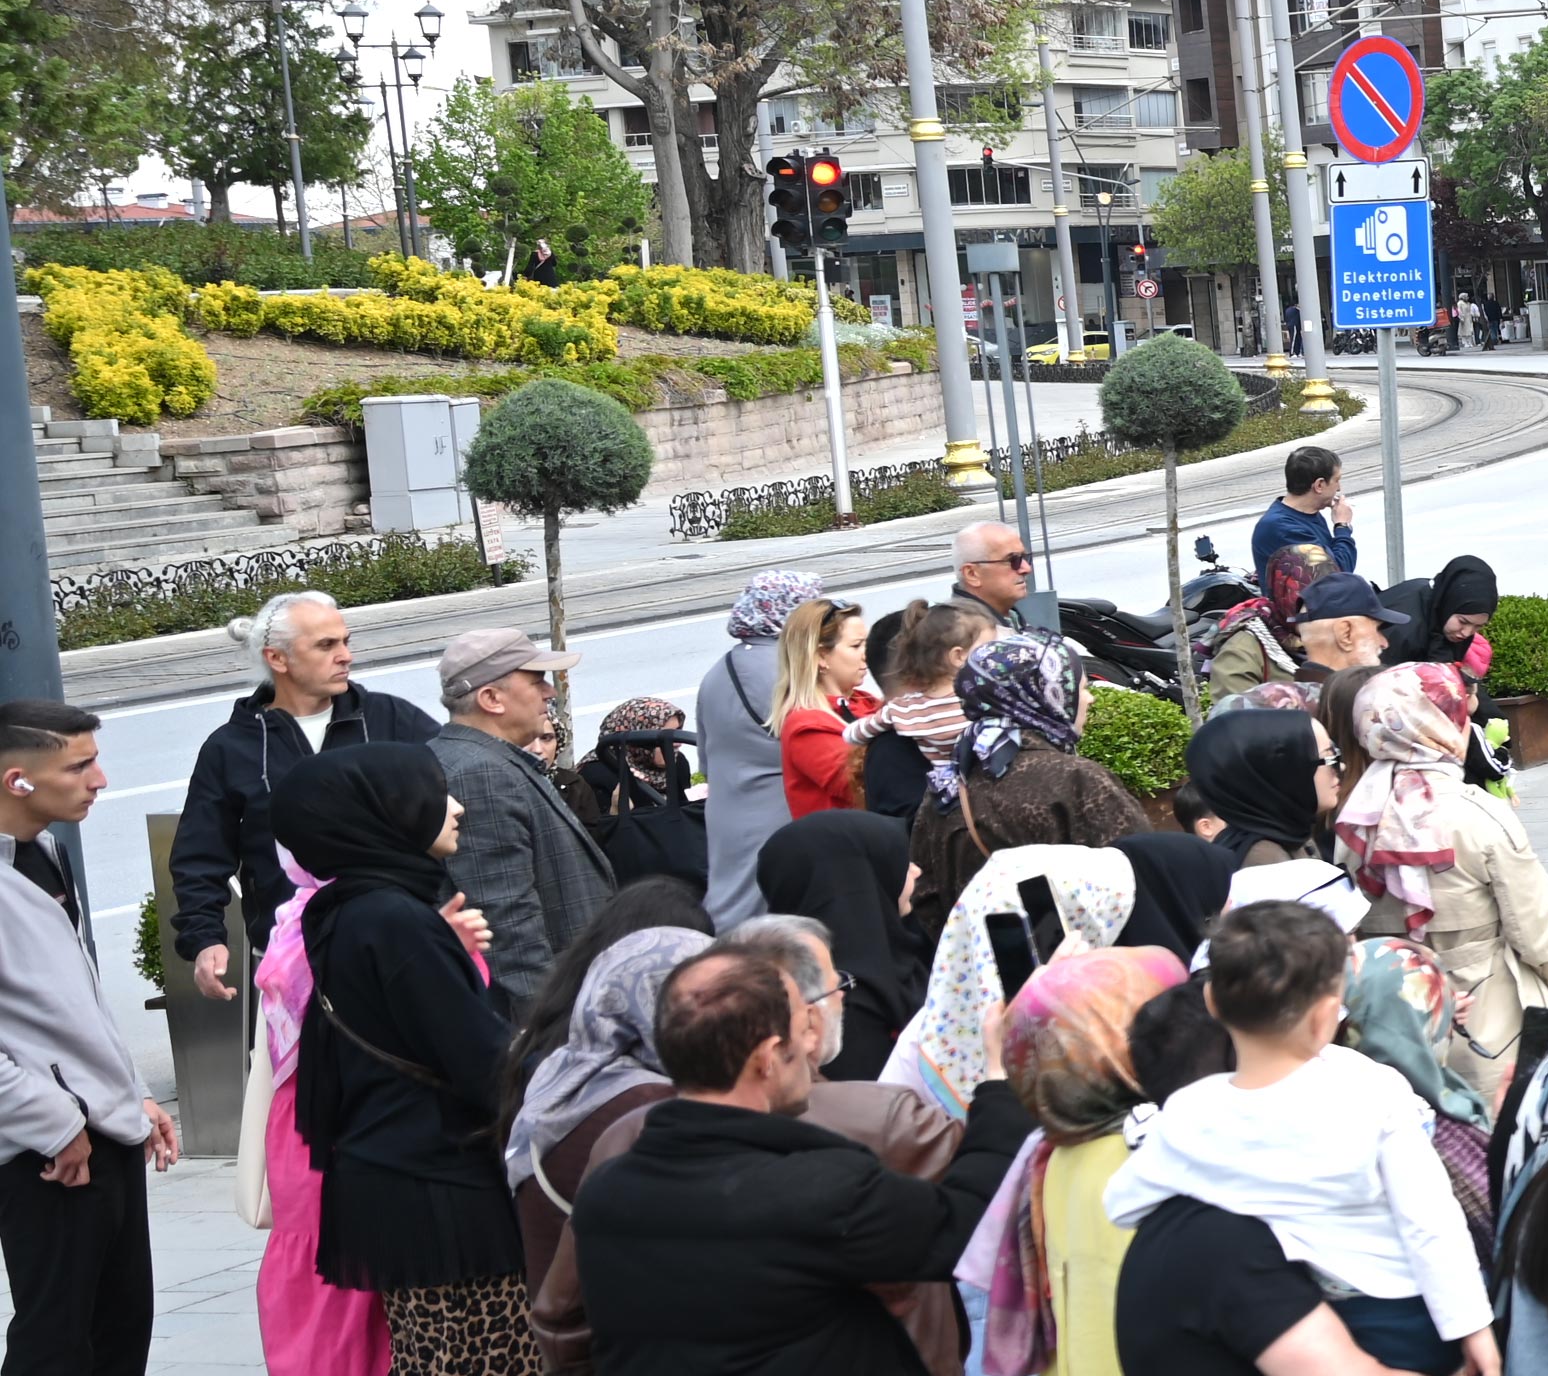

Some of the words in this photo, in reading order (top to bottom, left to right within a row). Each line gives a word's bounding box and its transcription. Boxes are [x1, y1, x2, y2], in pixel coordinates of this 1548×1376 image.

[1343, 269, 1422, 284] Elektronik
[1342, 288, 1425, 302] Denetleme
[1355, 306, 1414, 319] Sistemi
